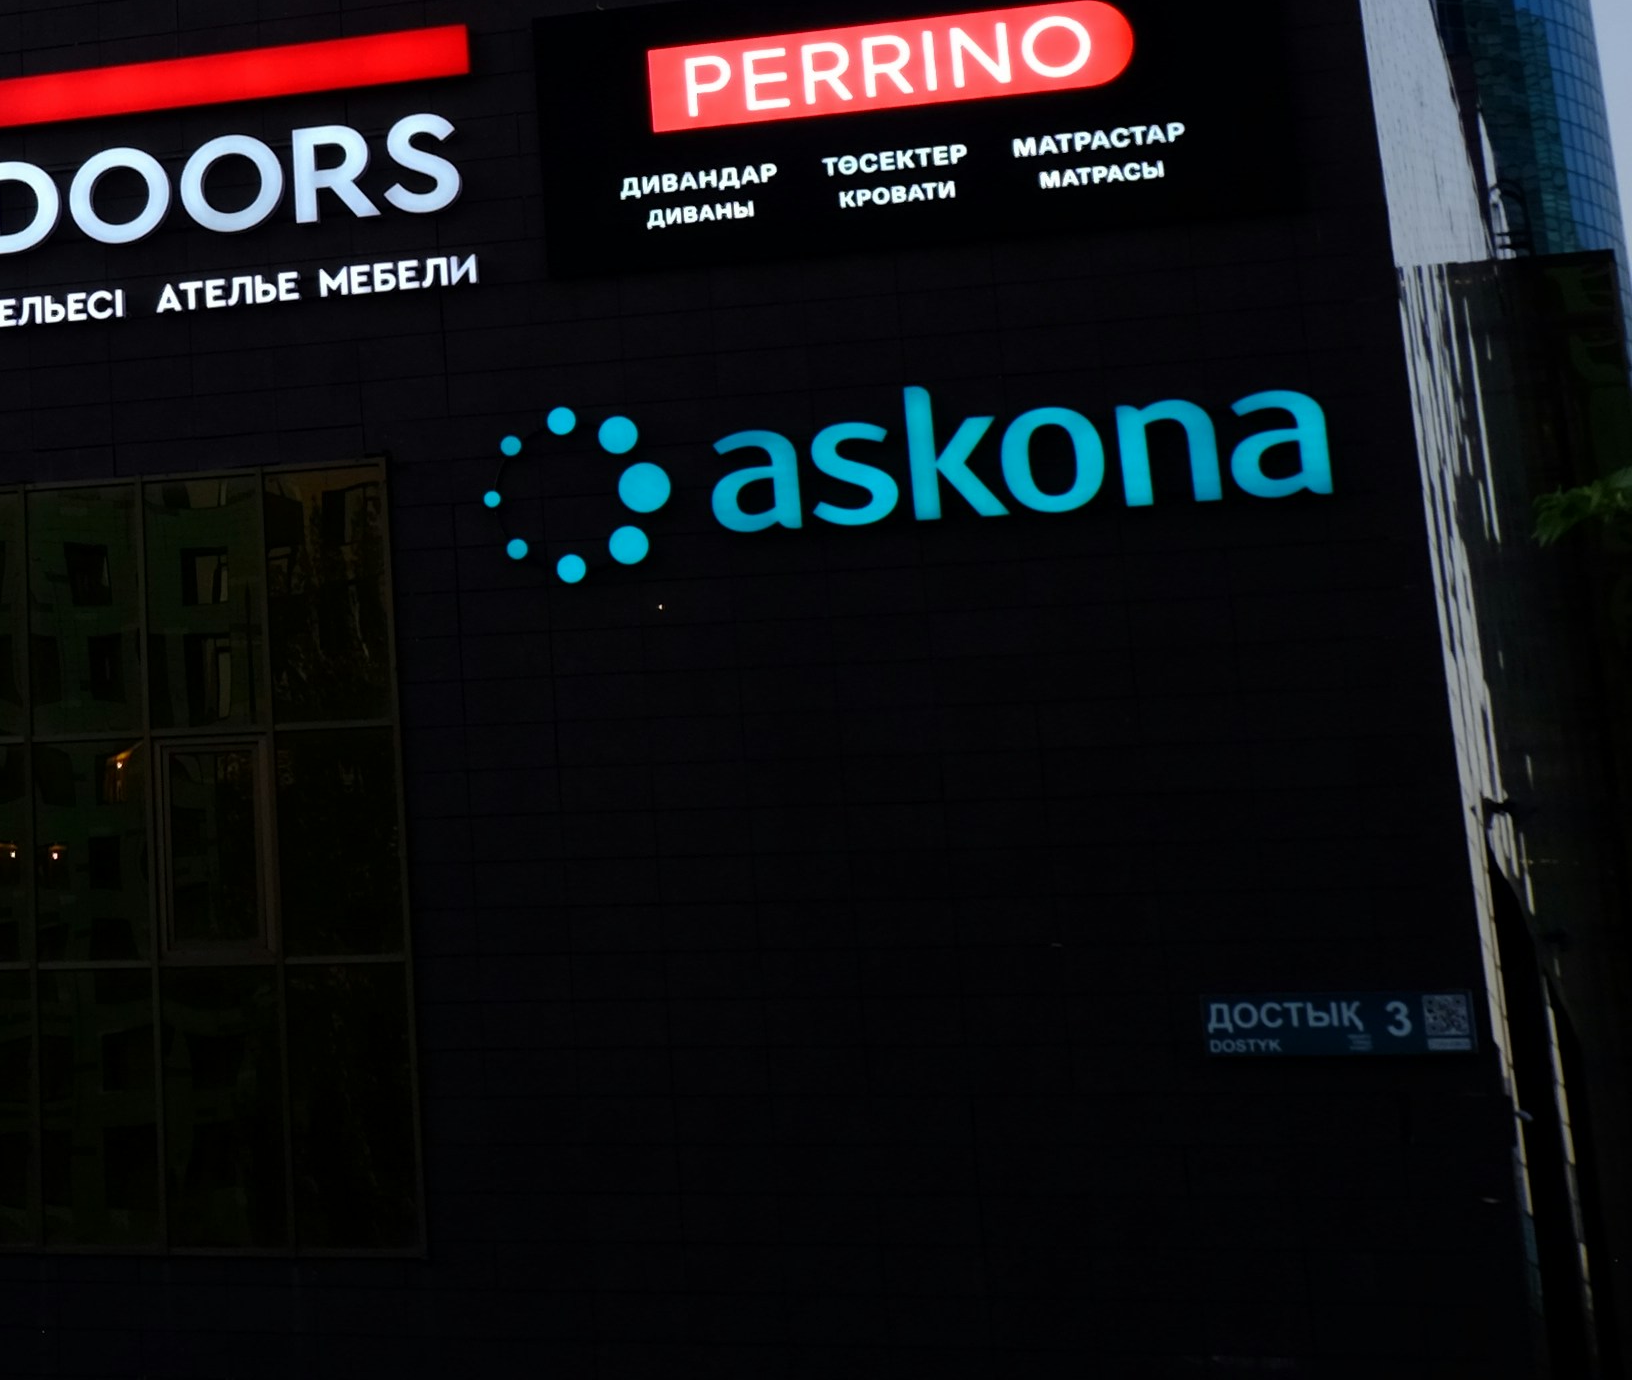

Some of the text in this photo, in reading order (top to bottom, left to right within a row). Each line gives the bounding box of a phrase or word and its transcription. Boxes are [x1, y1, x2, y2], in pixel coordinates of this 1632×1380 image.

[683, 14, 1092, 118] PERRINO
[1011, 122, 1186, 159] МАТРАСТАР
[821, 144, 968, 178] ТӨСЕКТЕР
[1038, 160, 1166, 189] МАТРАСЫ
[619, 163, 777, 200] ДИВАНДАР
[838, 181, 956, 209] КРОВАТИ
[646, 200, 755, 229] ДИВАНЫ
[156, 271, 300, 313] АТЕЛЬЕ
[318, 253, 479, 298] МЕБЕЛИ
[711, 385, 1334, 533] askona
[1207, 1001, 1412, 1037] ДОСТЫҚ 3
[1210, 1038, 1282, 1053] DOSTYK
